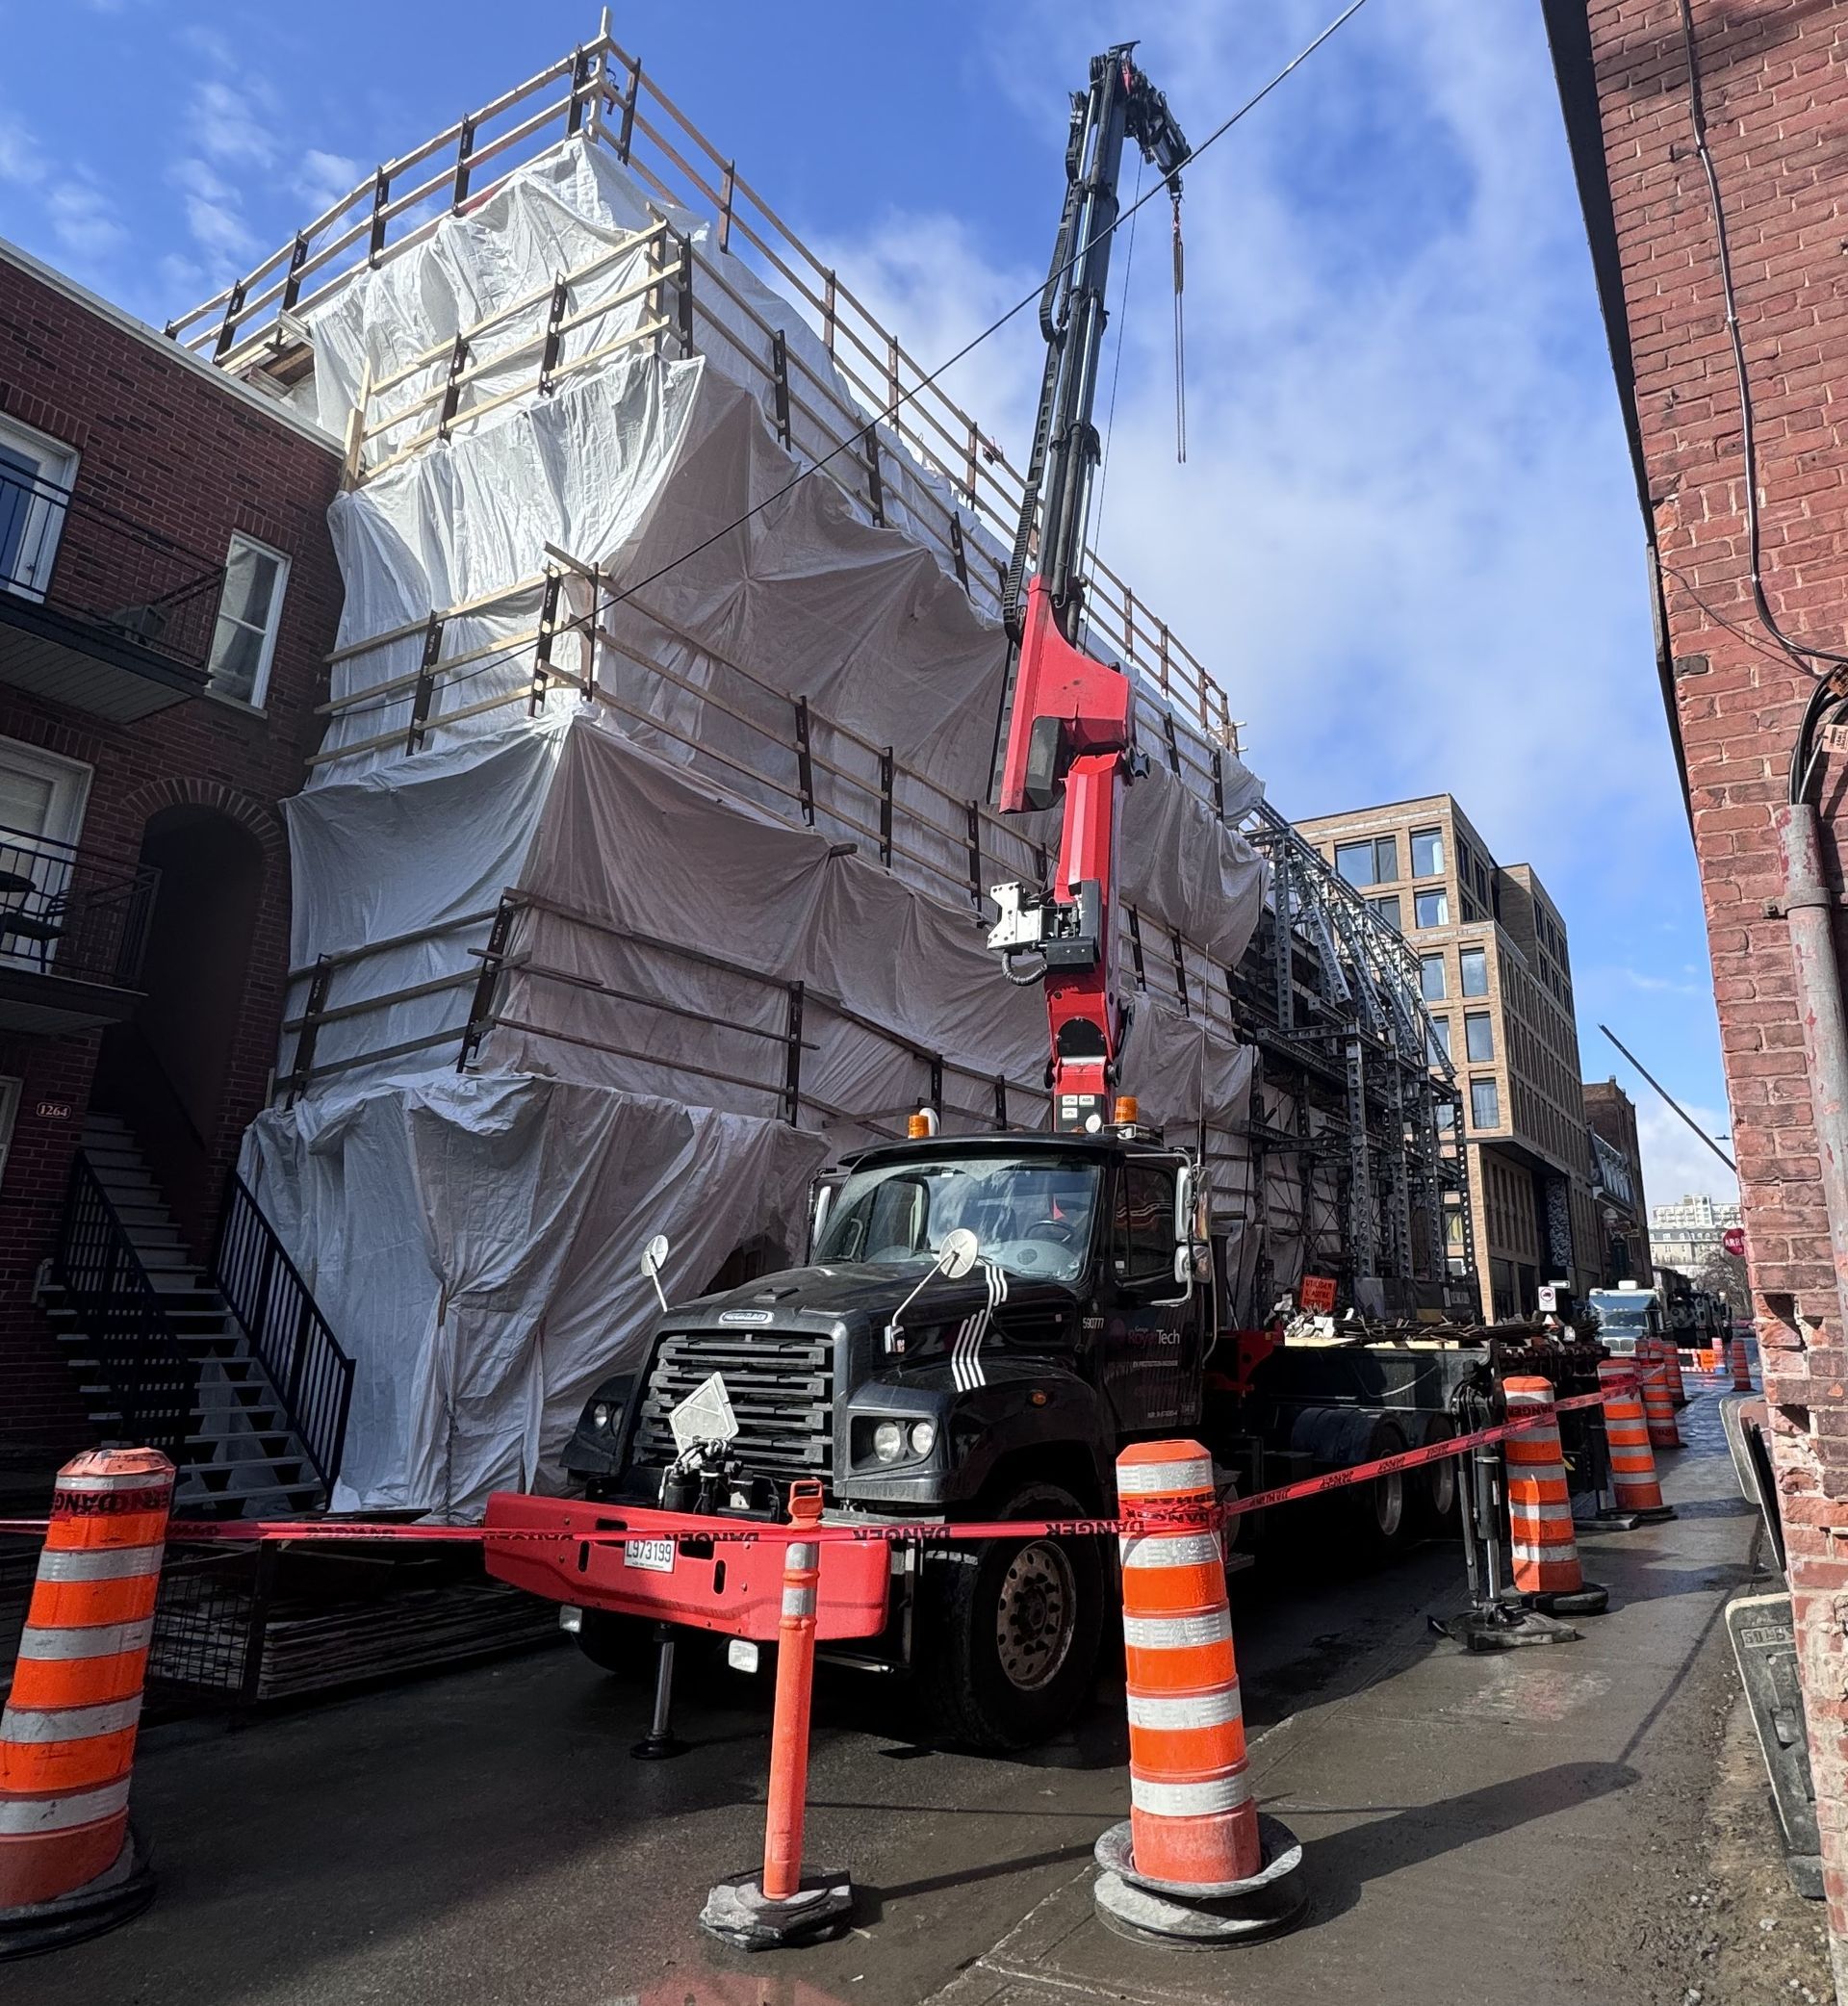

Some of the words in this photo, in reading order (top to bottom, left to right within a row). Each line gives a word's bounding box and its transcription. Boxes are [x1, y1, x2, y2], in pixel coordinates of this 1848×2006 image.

[39, 1104, 68, 1117] 1264
[1082, 1318, 1104, 1329] 590777
[1045, 1520, 1144, 1535] DANGER
[626, 1540, 672, 1563] L973199
